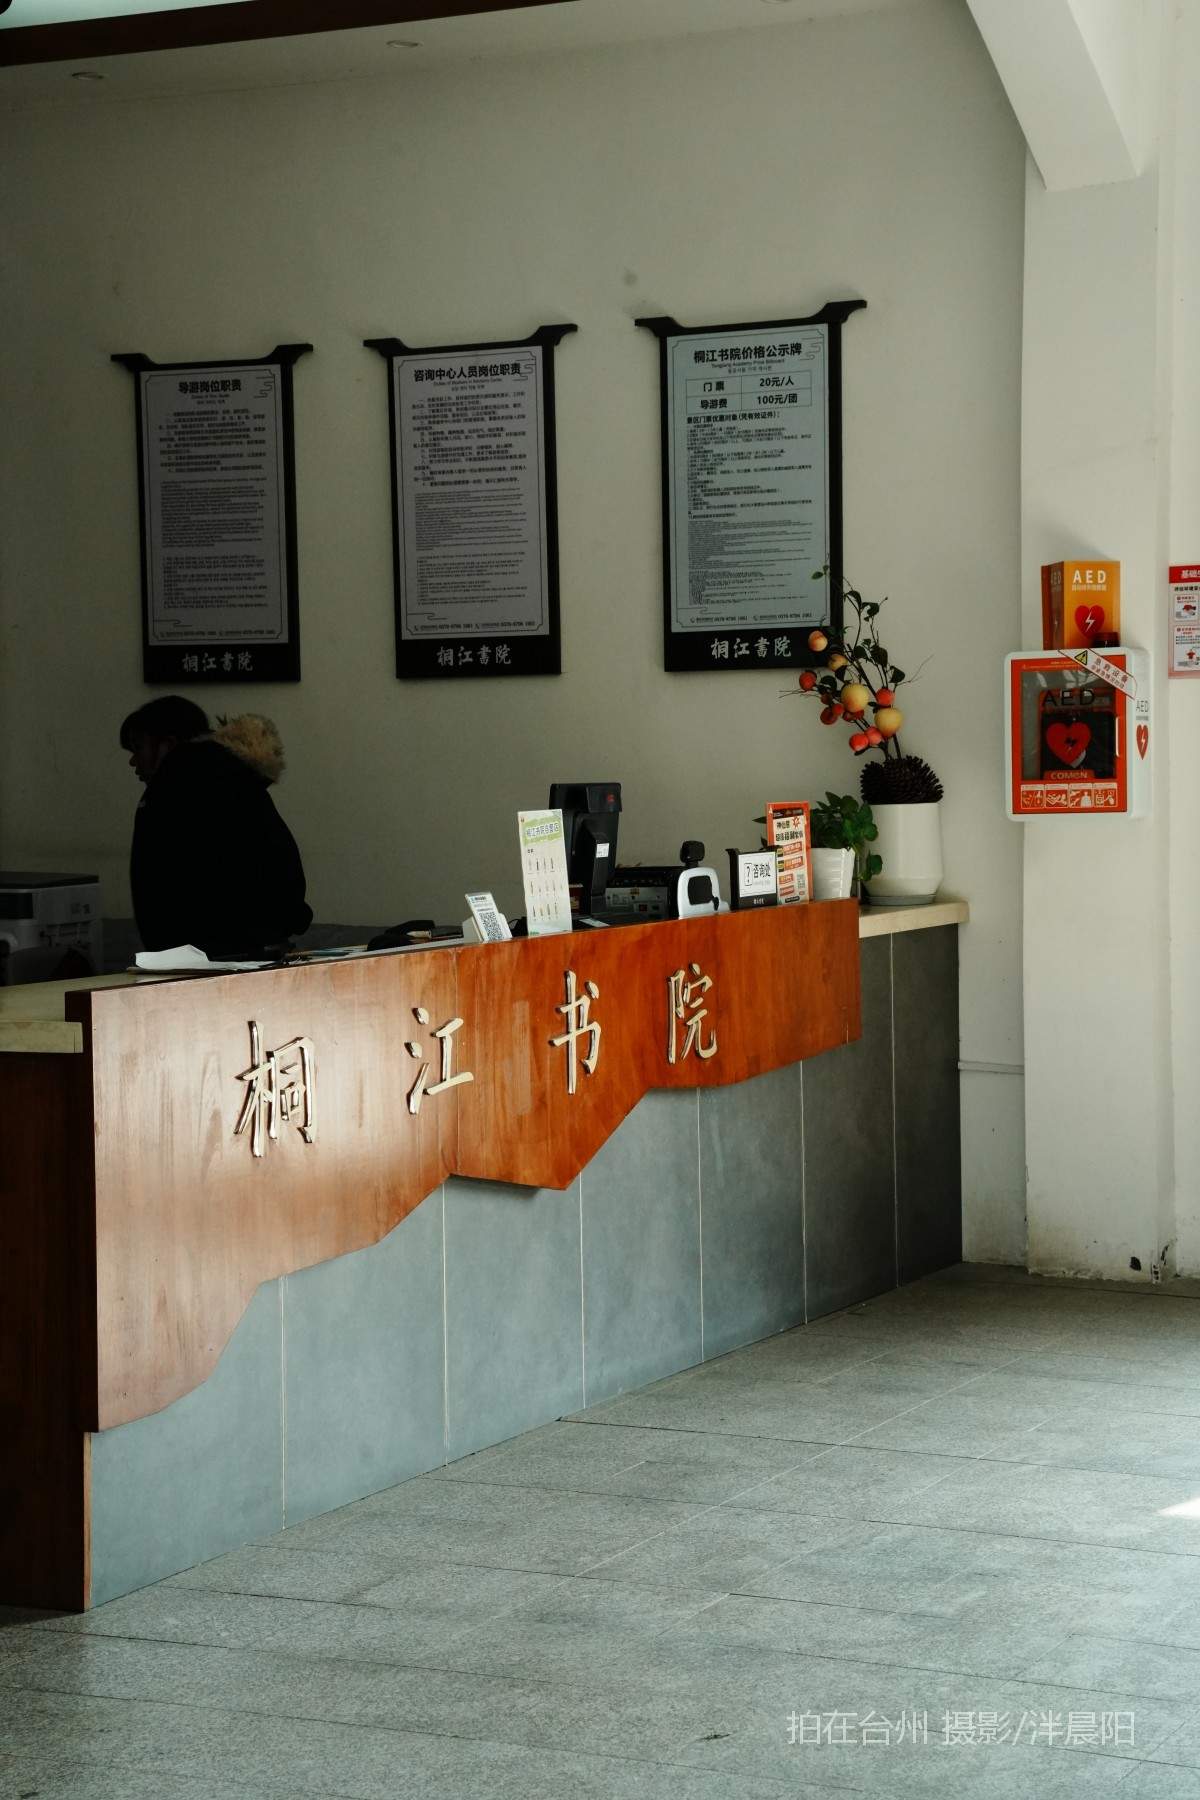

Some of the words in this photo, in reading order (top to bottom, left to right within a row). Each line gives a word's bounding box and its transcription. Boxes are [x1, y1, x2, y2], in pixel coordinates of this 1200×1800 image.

[694, 342, 802, 364] 桐江书院价格公示牌
[414, 363, 521, 382] 咨询中心人员岗位职责
[178, 378, 242, 394] 导游岗位职责
[759, 376, 795, 387] 20元/人
[700, 398, 728, 410] 导游费
[757, 393, 798, 405] 100元/团
[1073, 569, 1106, 584] AED
[1041, 689, 1097, 706] AED
[1136, 700, 1149, 713] AED
[753, 863, 771, 878] 咨询处
[234, 963, 718, 1157] 桐江书院
